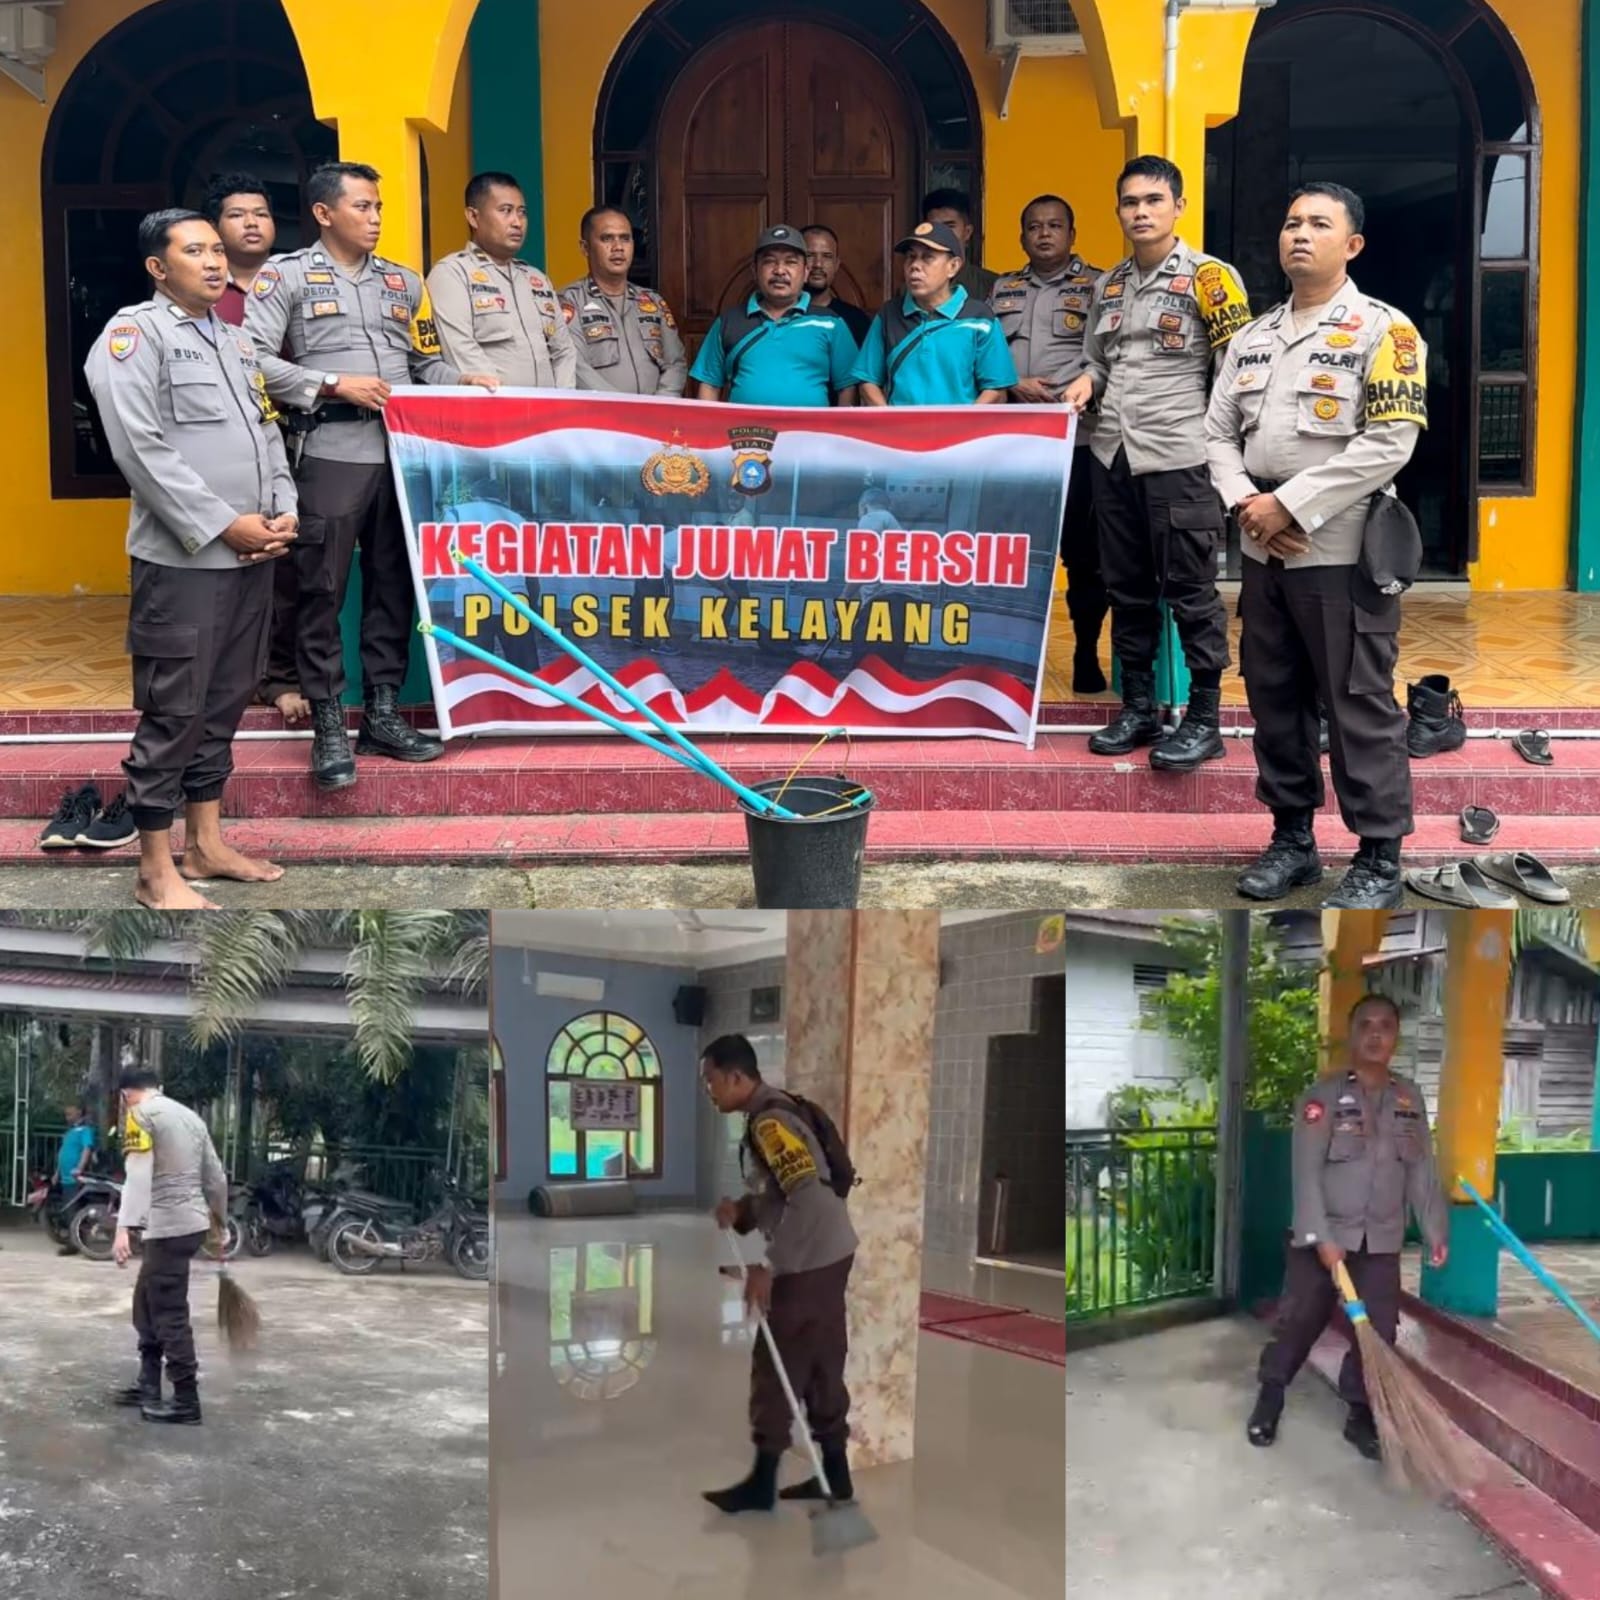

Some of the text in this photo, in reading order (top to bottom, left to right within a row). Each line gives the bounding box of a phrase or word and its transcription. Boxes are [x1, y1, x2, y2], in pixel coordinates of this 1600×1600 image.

[174, 348, 205, 361] BUDI
[1308, 352, 1358, 369] POLRI
[735, 440, 769, 449] RIAU
[420, 521, 1030, 587] KEGIATAN JUMAT BERSIH
[464, 594, 971, 645] POLSEK KELAYANG
